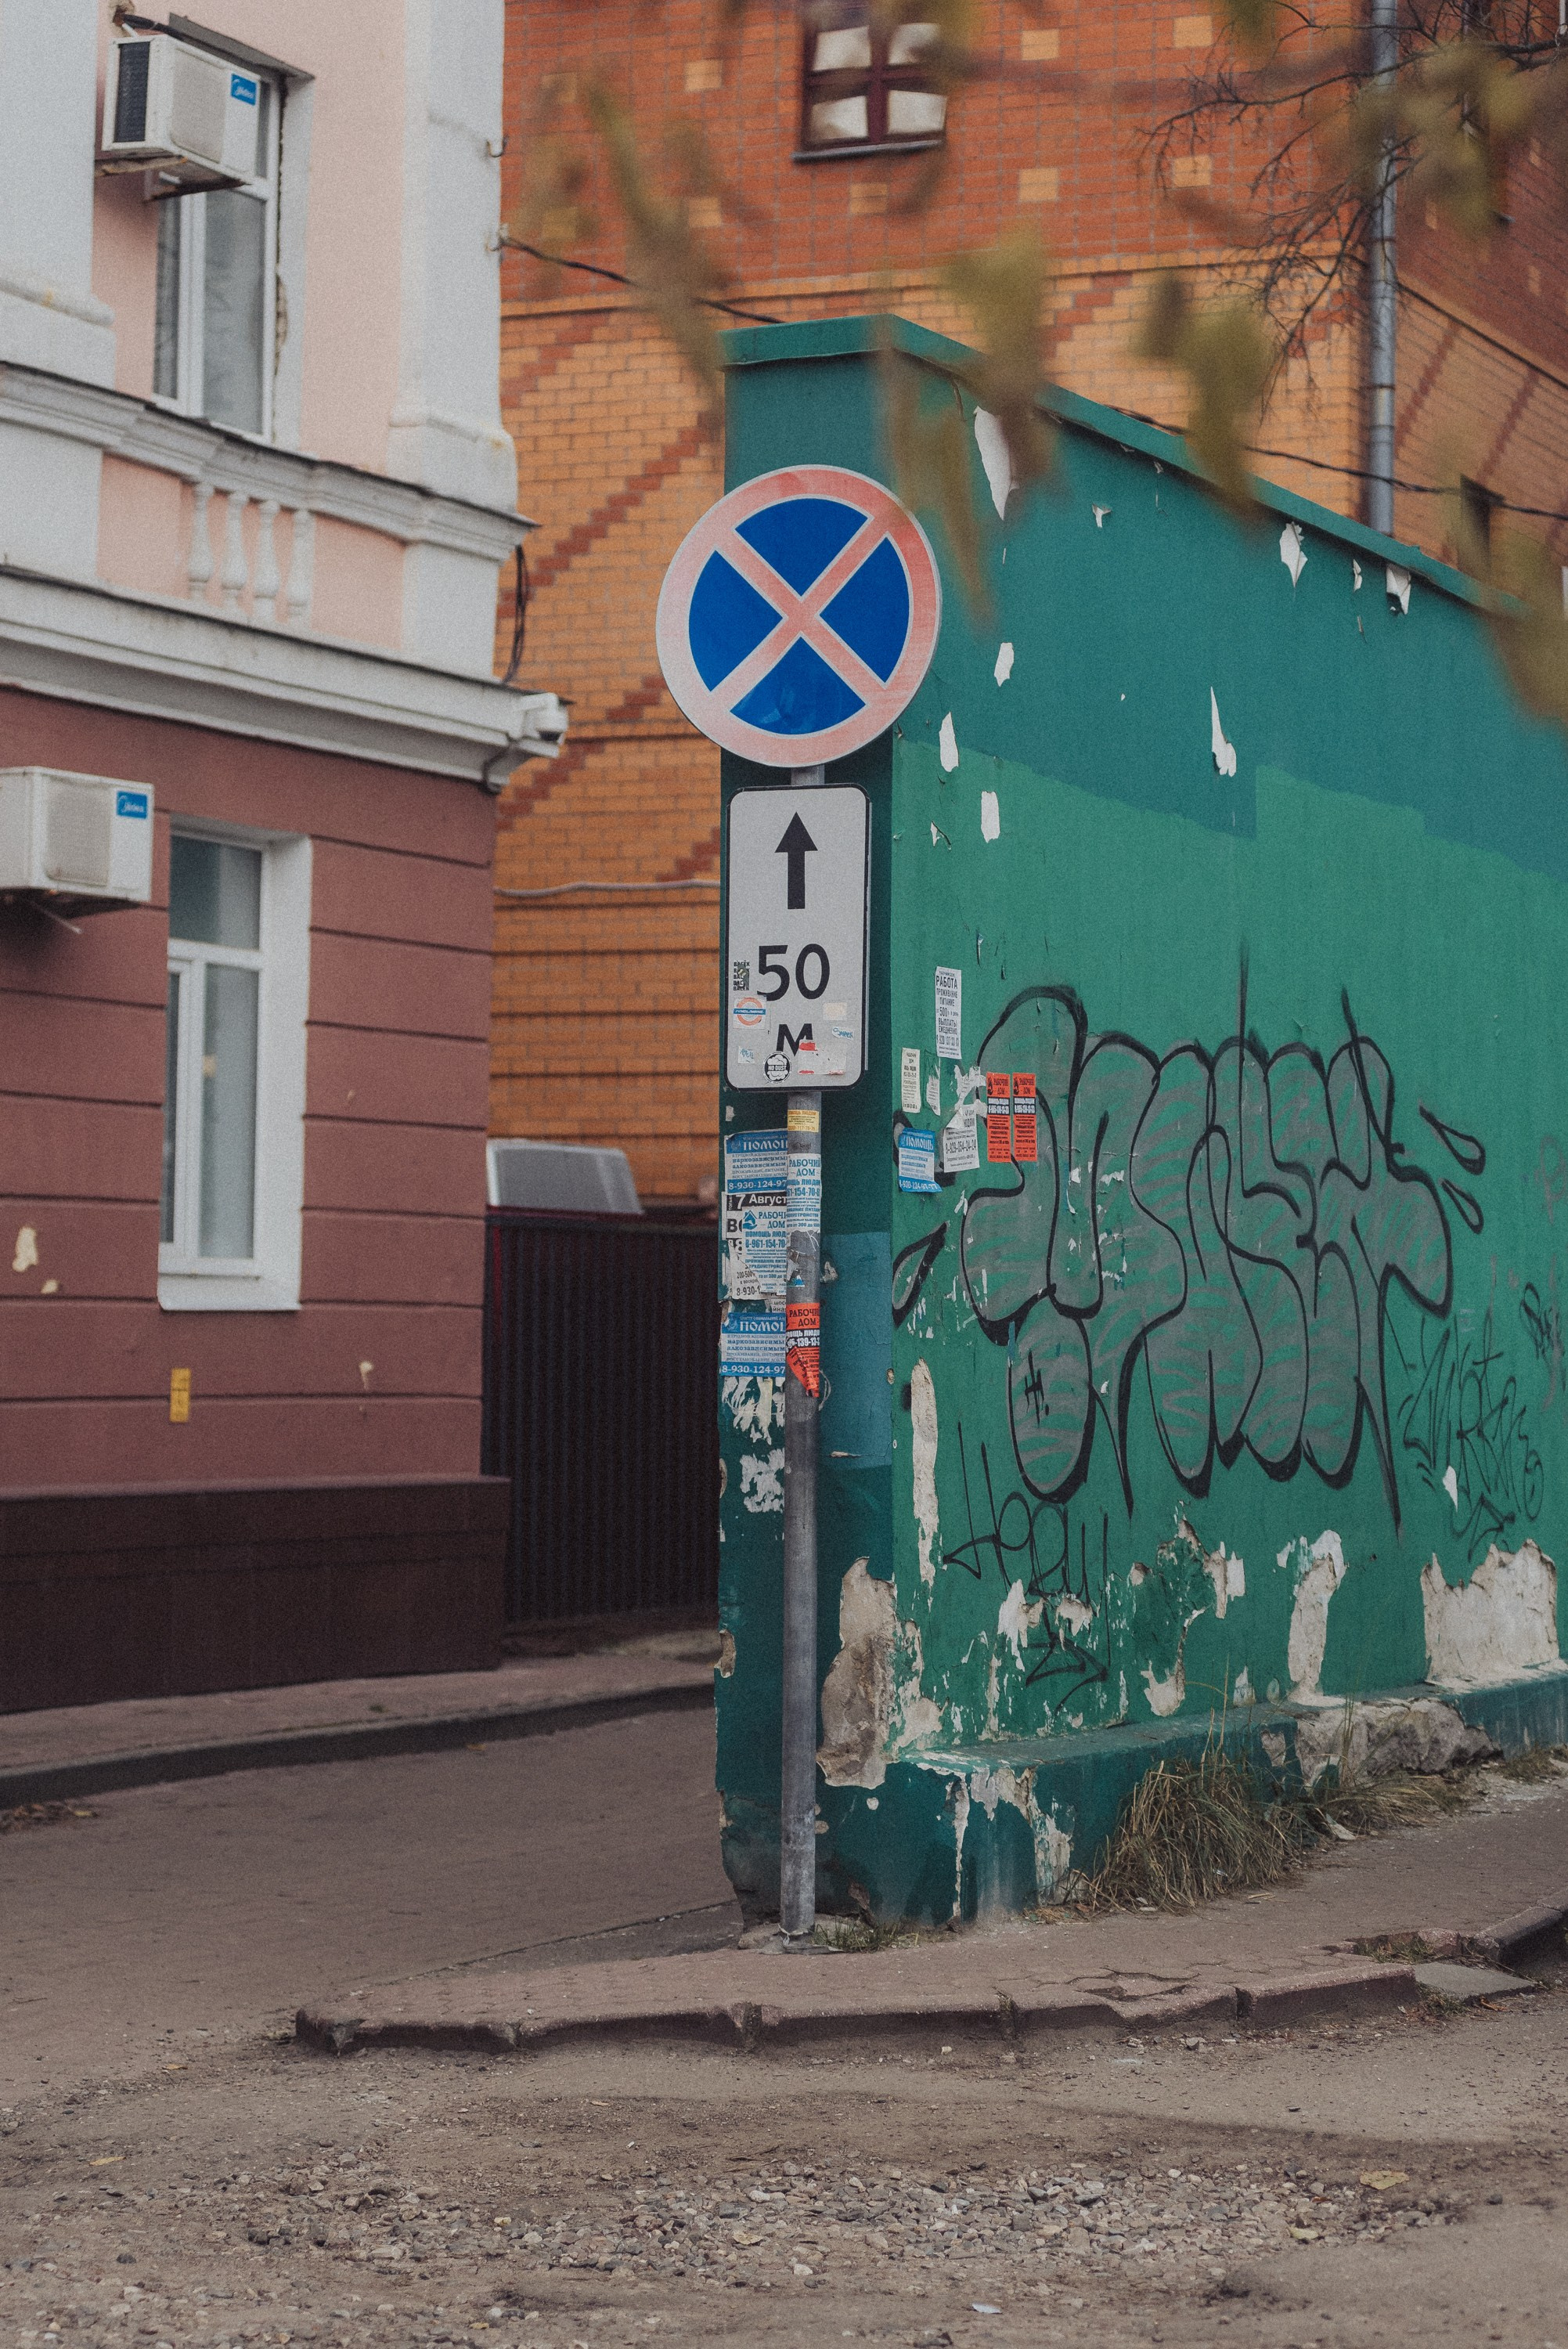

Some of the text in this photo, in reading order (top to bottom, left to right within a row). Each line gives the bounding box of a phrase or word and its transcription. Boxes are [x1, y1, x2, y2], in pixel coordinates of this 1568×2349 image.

[757, 944, 830, 1001] 50
[936, 976, 958, 989] РАБОТА
[906, 1136, 934, 1151] ПОМОЩЬ
[796, 1168, 815, 1177] ДОМ
[736, 1194, 746, 1210] 7
[767, 1221, 785, 1229] ДОМ
[798, 1318, 816, 1327] ДОМ
[722, 1365, 786, 1374] 8-930-124-97
